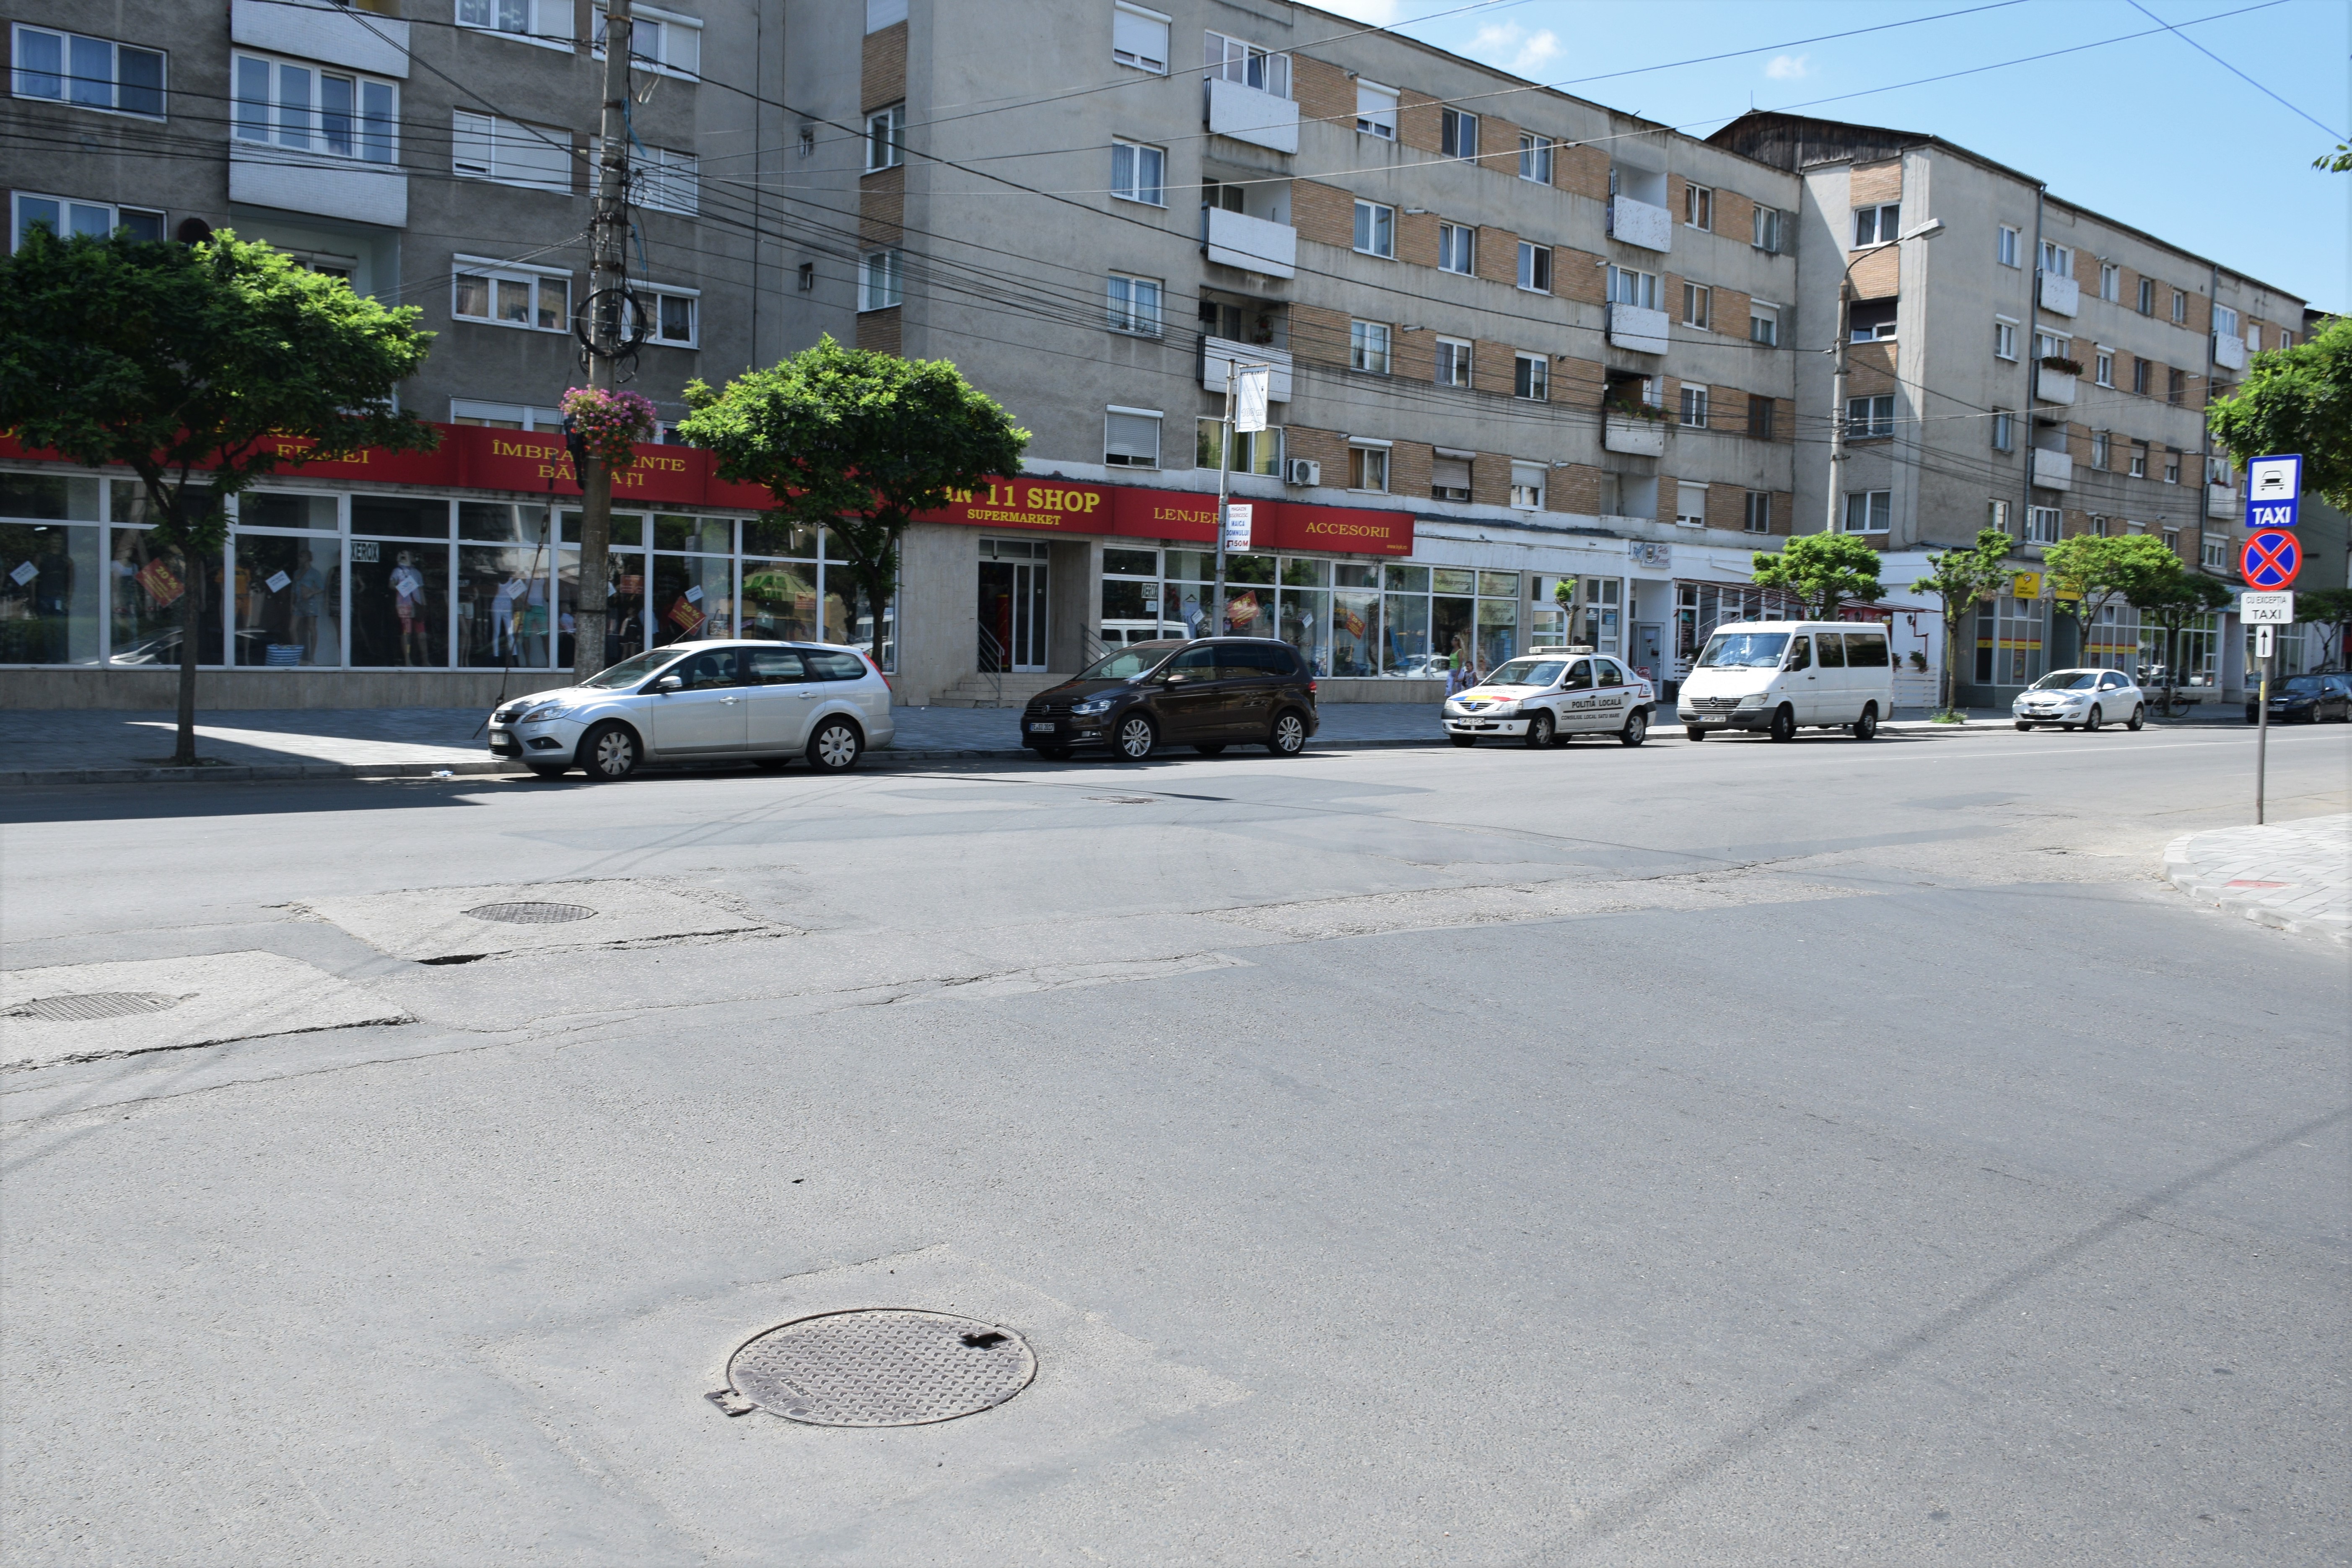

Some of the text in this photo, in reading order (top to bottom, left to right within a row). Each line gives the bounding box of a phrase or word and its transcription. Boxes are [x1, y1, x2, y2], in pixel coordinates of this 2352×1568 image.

[1241, 408, 1255, 417] 100
[1027, 487, 1101, 513] SHOP
[967, 508, 1062, 525] SUPERMARKET
[2252, 506, 2291, 525] TAXI
[1305, 522, 1390, 538] ACCESORII
[350, 542, 378, 560] XEROX
[1142, 584, 1157, 597] XEROX
[682, 602, 692, 612] 20
[2252, 609, 2281, 619] TAXI
[1599, 697, 1621, 707] LOCALĂ
